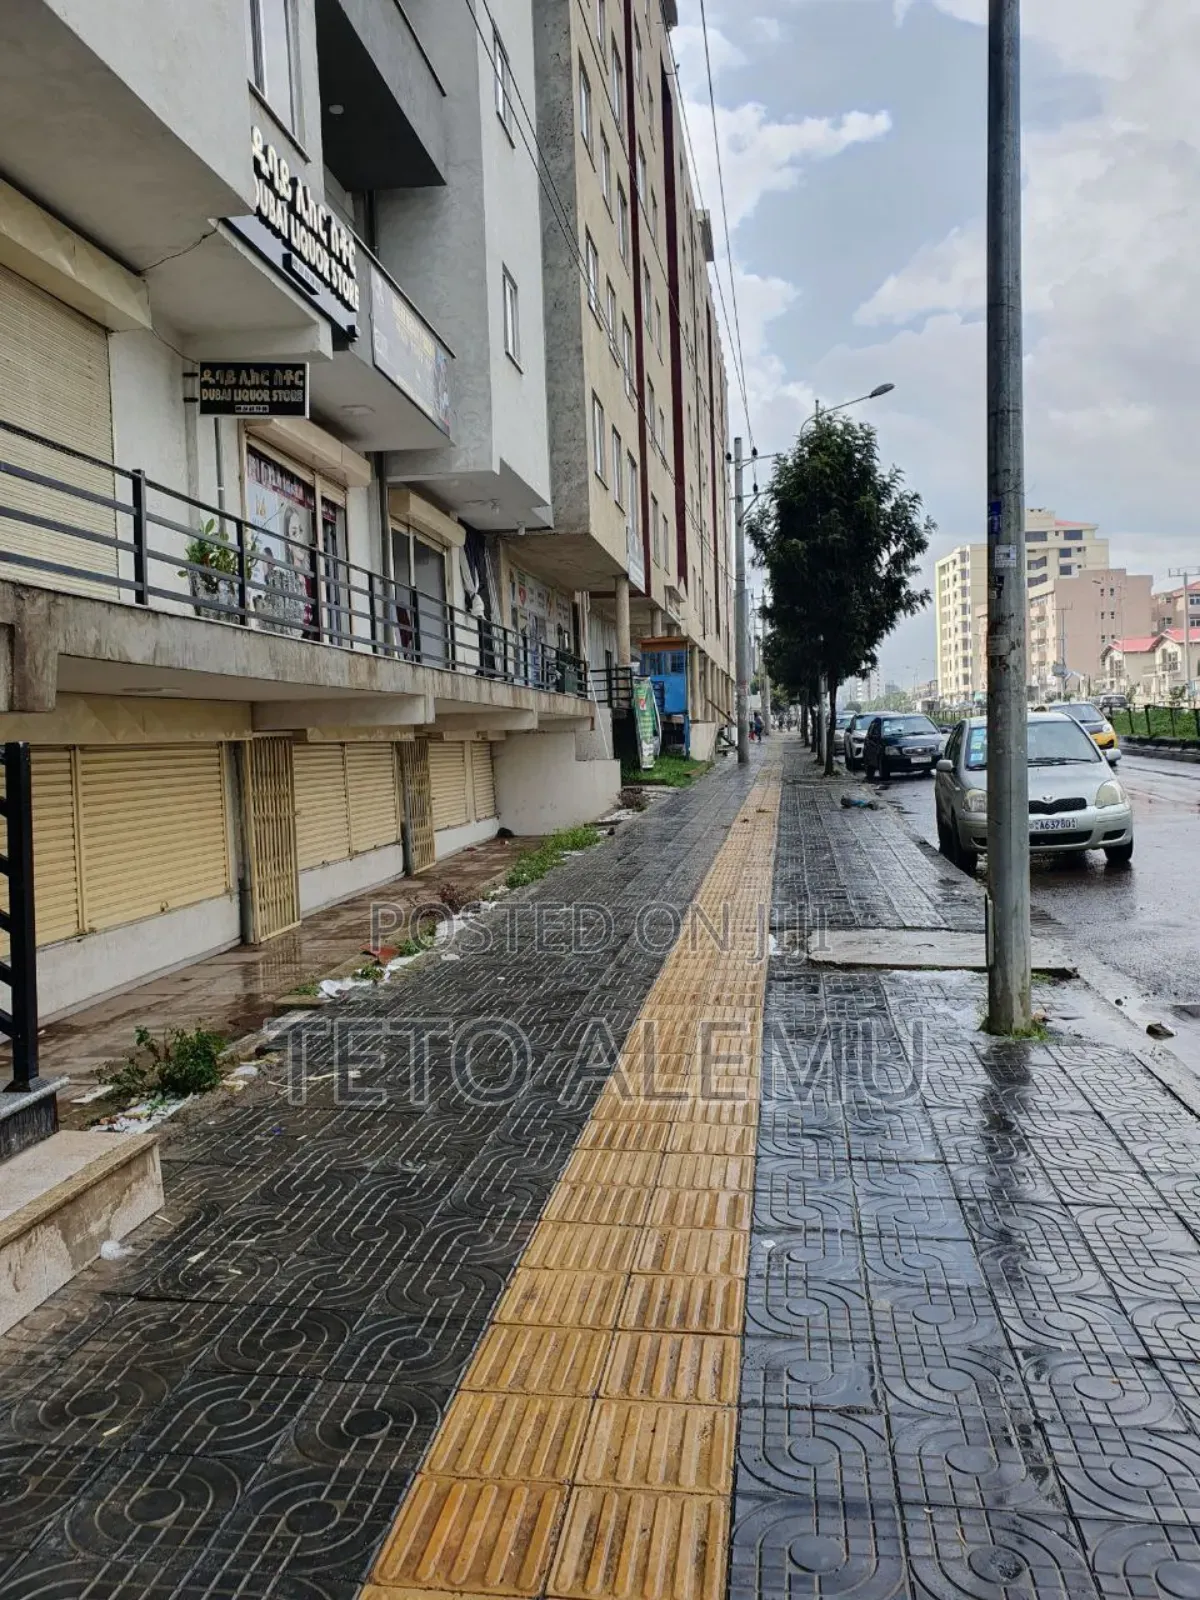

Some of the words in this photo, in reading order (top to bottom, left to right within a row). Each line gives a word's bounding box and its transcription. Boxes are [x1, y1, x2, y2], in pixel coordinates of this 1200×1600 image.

[289, 213, 331, 283] LIQUOR
[331, 256, 360, 313] STORE
[201, 388, 232, 401] DUBAI
[233, 388, 271, 402] LIQUOR
